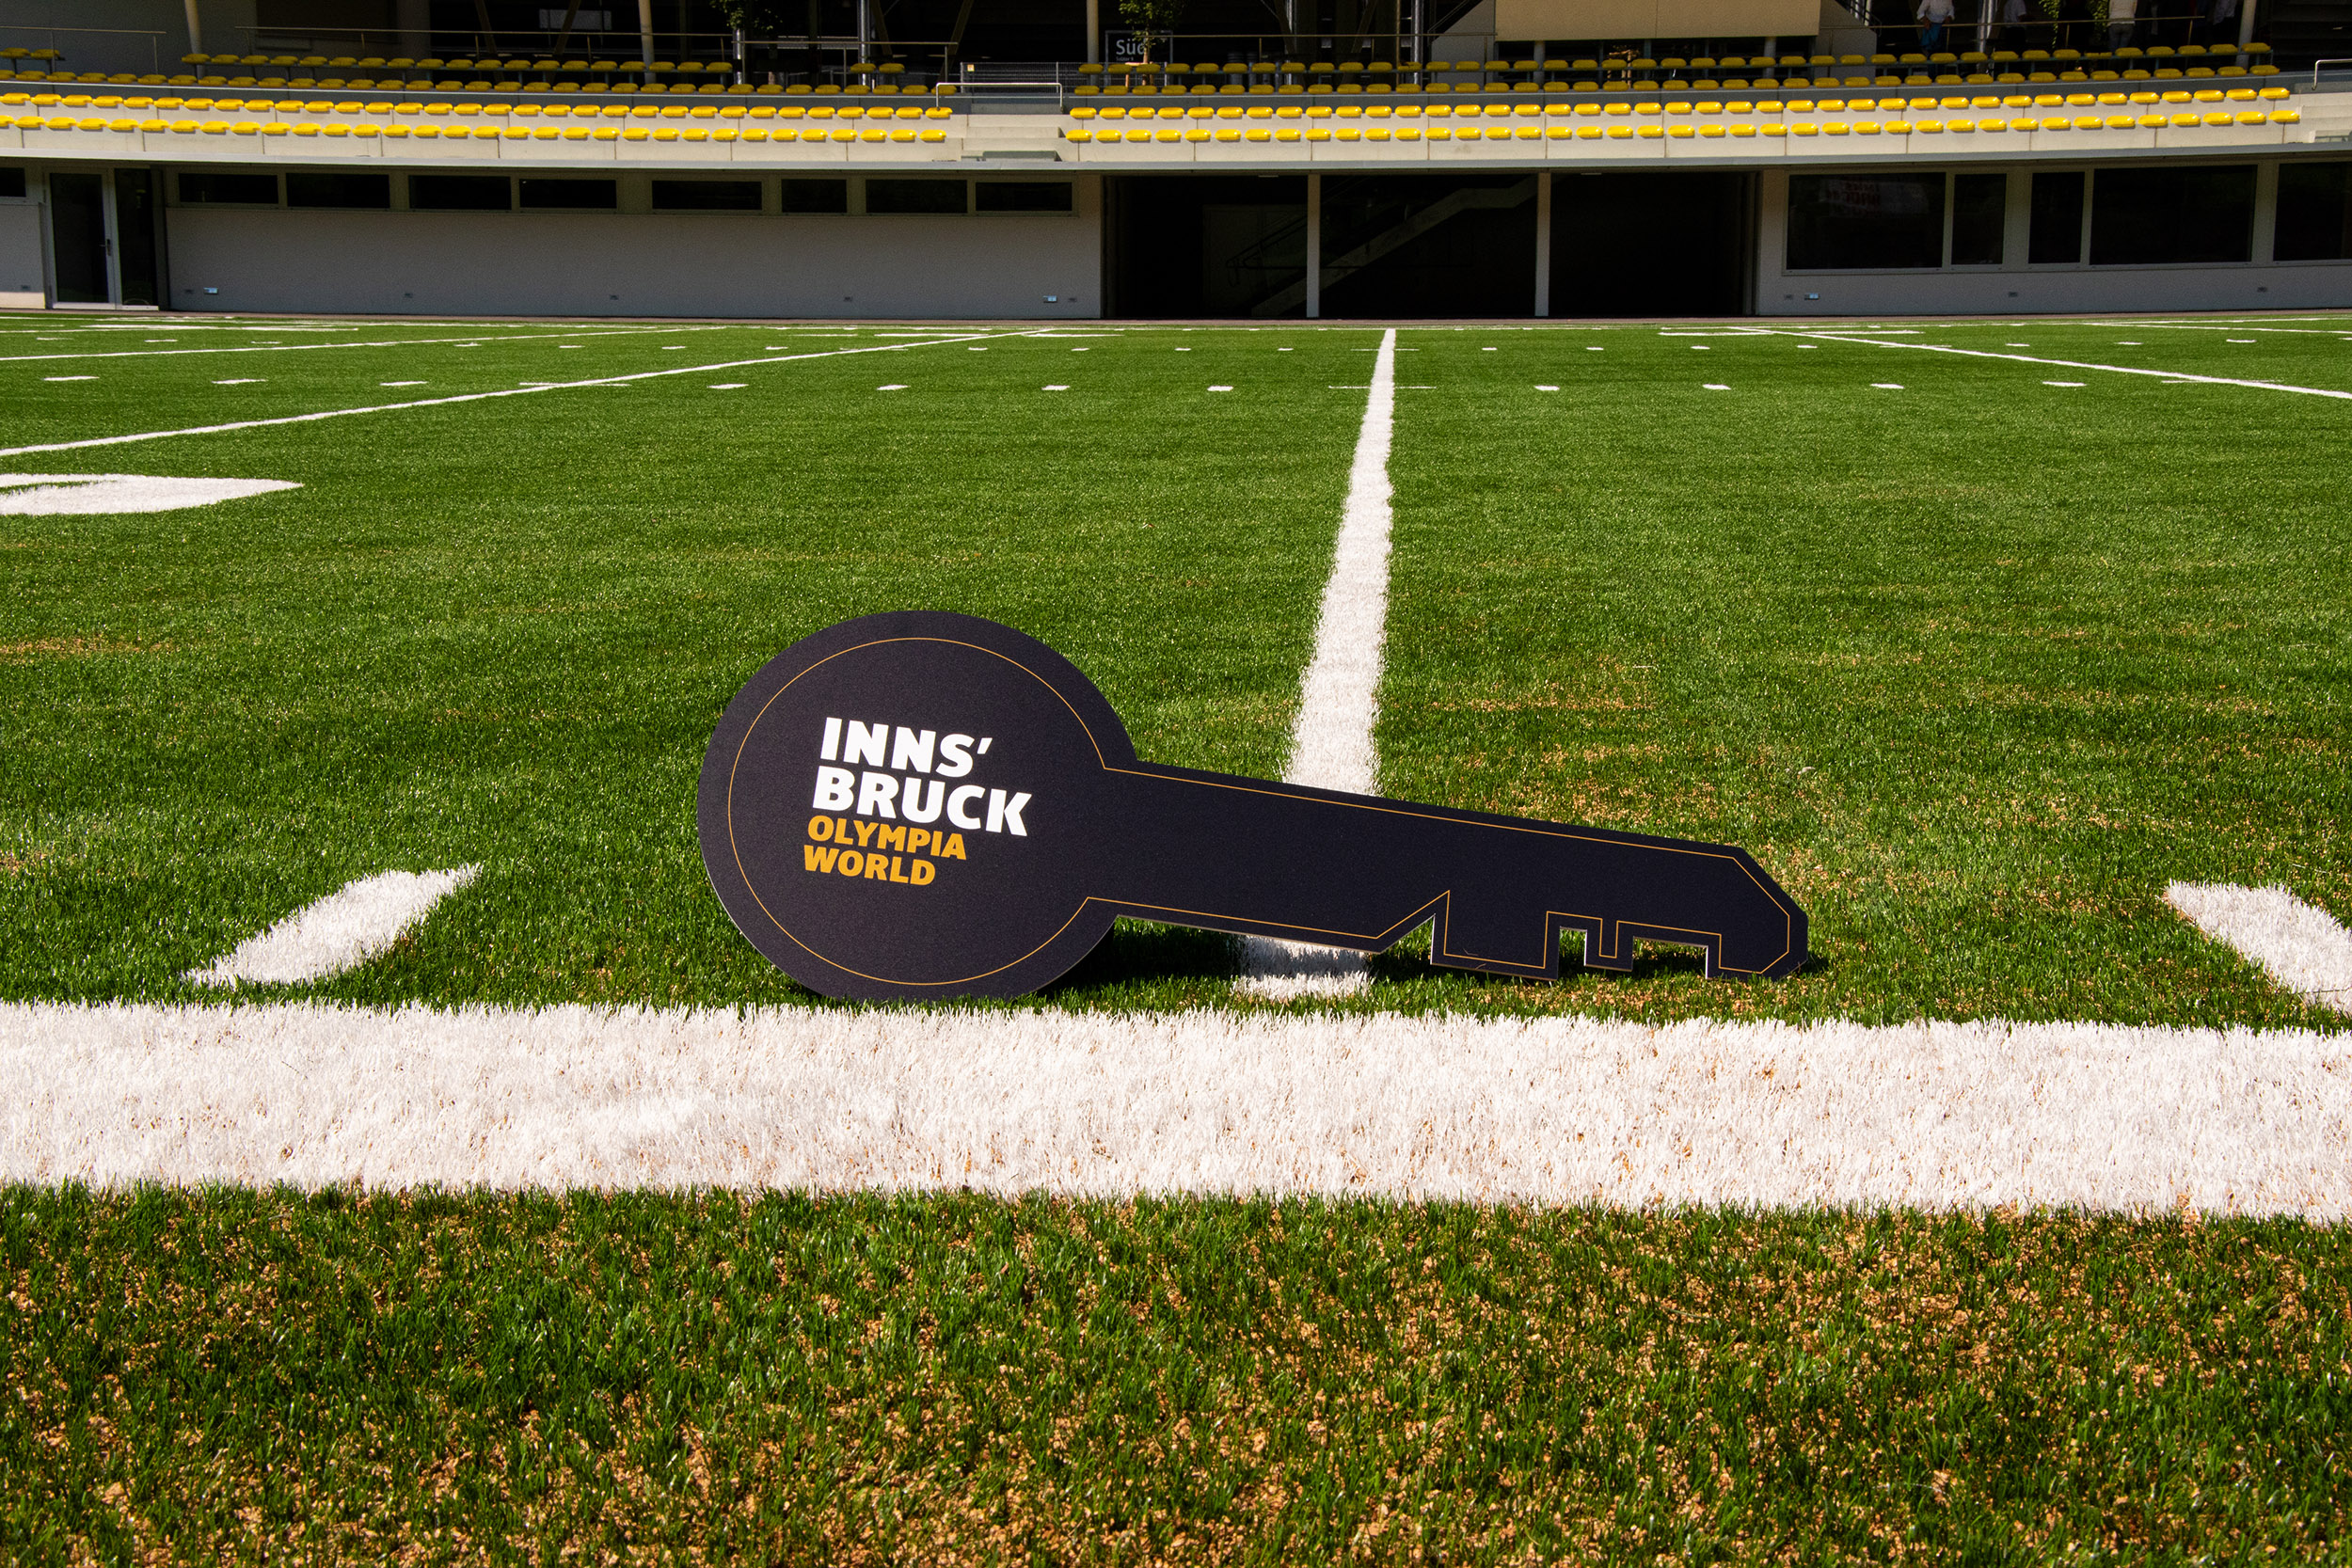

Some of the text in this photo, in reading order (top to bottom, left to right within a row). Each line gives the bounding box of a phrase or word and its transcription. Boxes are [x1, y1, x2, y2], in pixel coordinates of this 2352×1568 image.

[819, 717, 993, 778] INNS'
[812, 765, 1032, 837] BRUCK
[807, 815, 967, 861] OLYMPIA
[803, 844, 936, 886] WORLD
